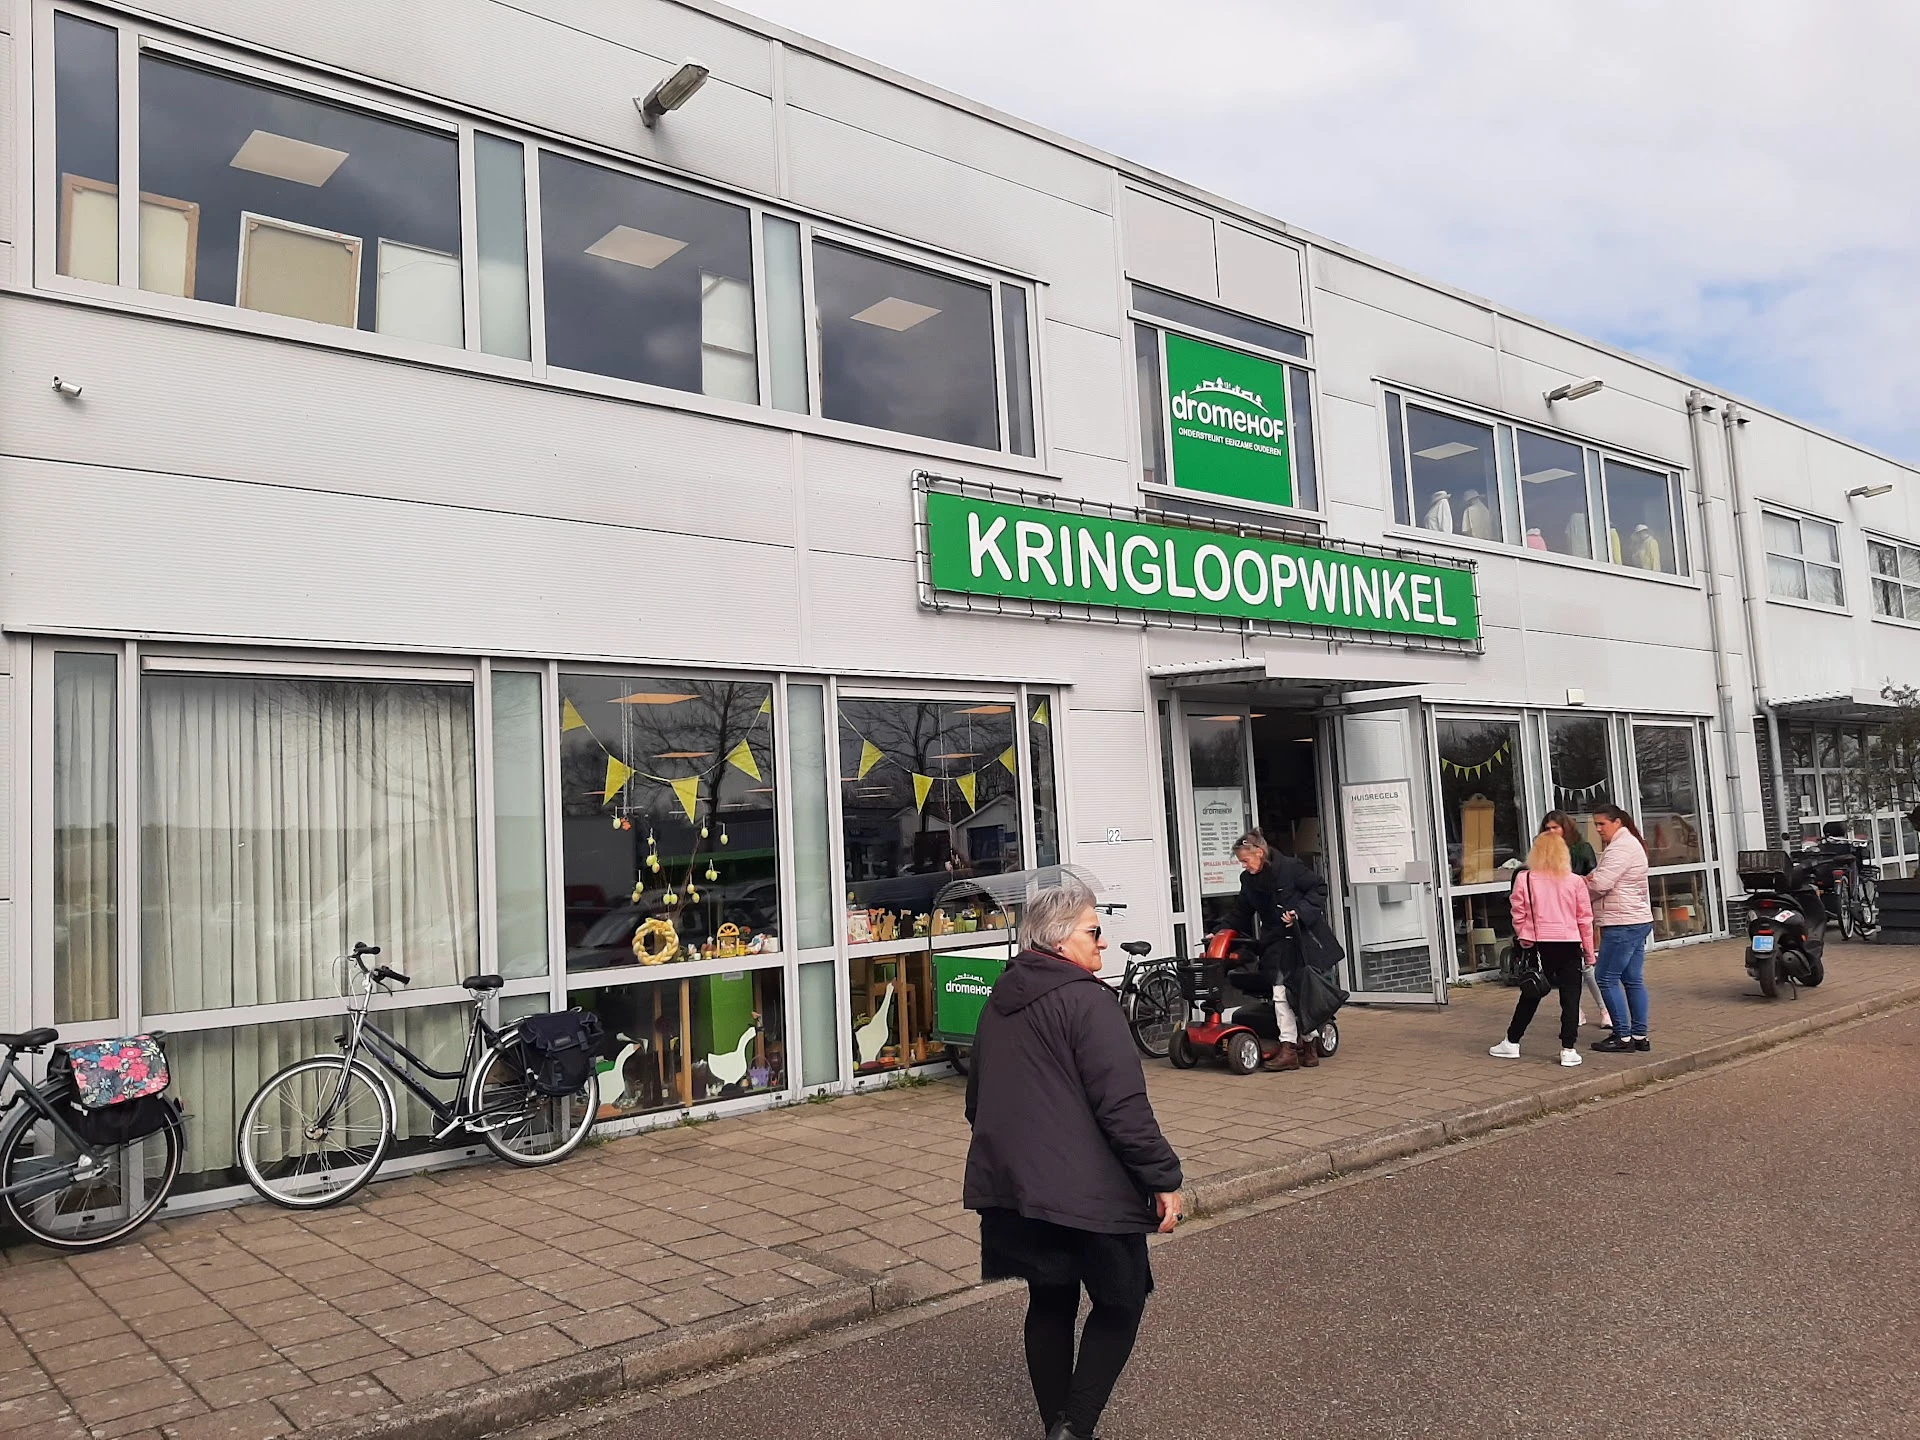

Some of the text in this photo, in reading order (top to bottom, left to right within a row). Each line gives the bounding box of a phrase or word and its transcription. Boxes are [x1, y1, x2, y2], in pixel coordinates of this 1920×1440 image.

[1178, 427, 1282, 457] ONDERSTEUNT EENZAME OUDEREN
[968, 511, 1458, 627] KRINGLOOPWINKEL
[1351, 791, 1399, 802] HUISREGELS
[1108, 829, 1121, 843] 22
